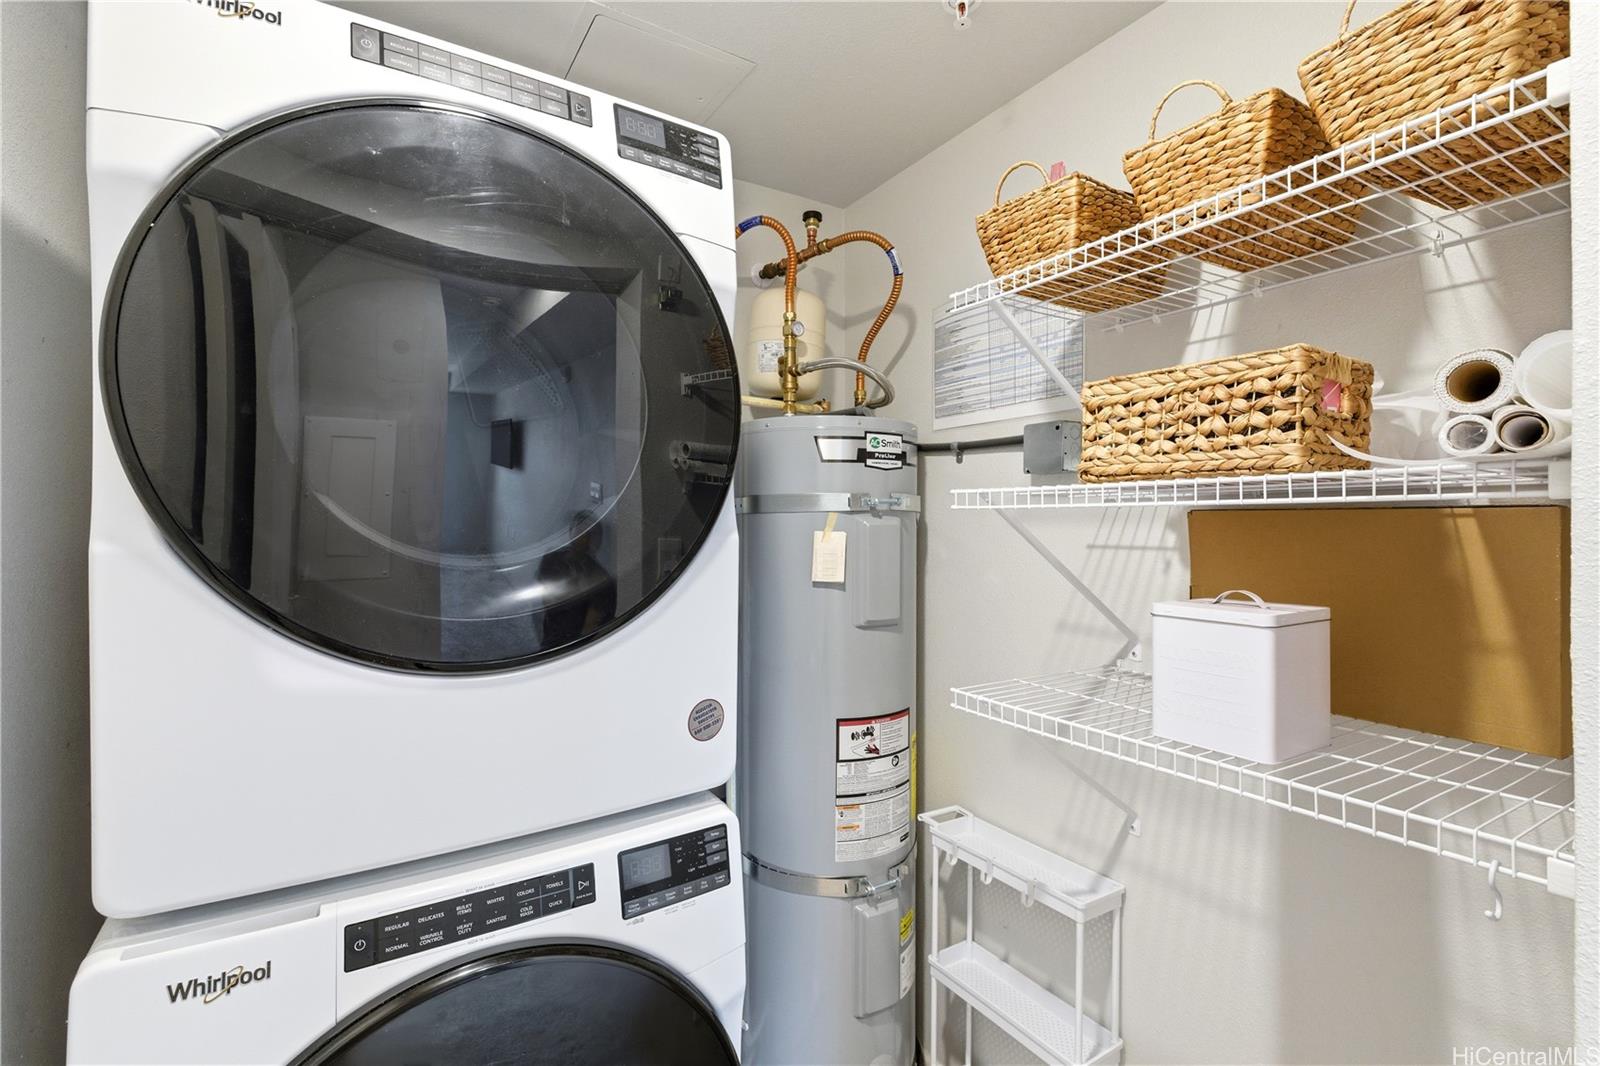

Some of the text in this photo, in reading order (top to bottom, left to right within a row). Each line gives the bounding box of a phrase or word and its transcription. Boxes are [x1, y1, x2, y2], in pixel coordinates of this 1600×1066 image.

[186, 0, 282, 26] hirlpool
[881, 439, 901, 449] Smith
[546, 880, 564, 889] TOWELS
[516, 888, 535, 897] COLORS
[486, 896, 505, 905] WHITES
[548, 899, 563, 908] QUICK
[519, 905, 533, 913] COLD
[418, 911, 445, 924] DELICATES
[486, 915, 507, 925] SANITIZE
[384, 921, 410, 932] REGULAR
[456, 922, 473, 930] HEAVY
[458, 927, 472, 935] DUTY
[420, 930, 443, 940] WRINKLE
[419, 936, 444, 946] CONTROL
[385, 942, 409, 953] NORMAL
[166, 960, 272, 1004] Whirlpool
